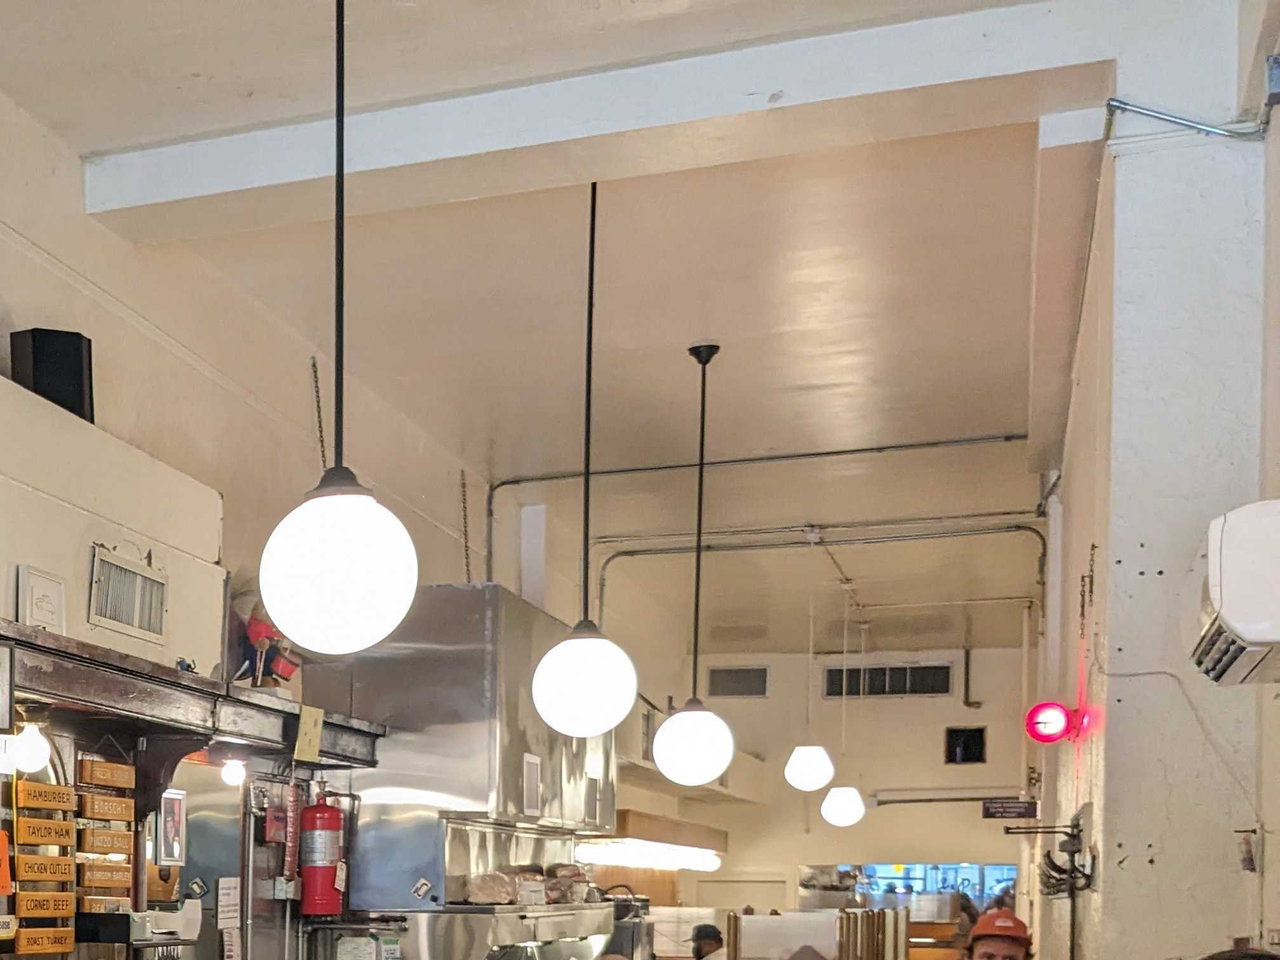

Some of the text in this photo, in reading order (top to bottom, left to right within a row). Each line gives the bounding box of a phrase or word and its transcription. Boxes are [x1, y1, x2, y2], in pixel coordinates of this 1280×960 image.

[26, 789, 71, 804] HAMBURGER
[94, 801, 127, 814] BORSCHT
[26, 825, 71, 840] TAYLOR HAM
[24, 862, 71, 875] CHICKEN CUTLET
[25, 899, 69, 911] CORNED BEEF
[26, 936, 68, 946] ROAST TURKEY
